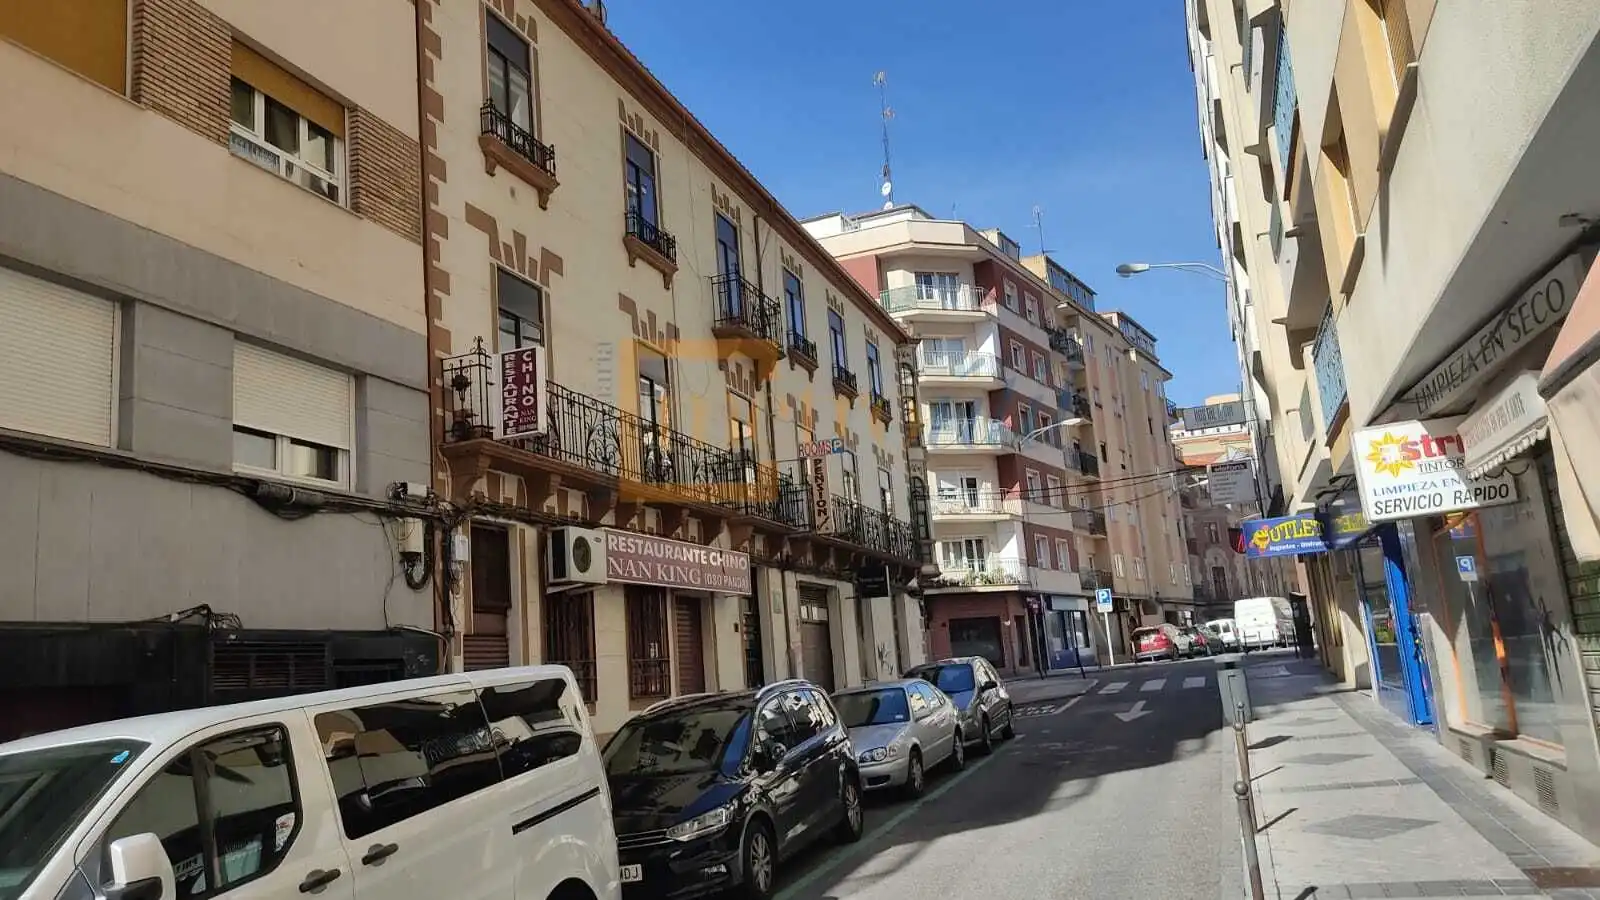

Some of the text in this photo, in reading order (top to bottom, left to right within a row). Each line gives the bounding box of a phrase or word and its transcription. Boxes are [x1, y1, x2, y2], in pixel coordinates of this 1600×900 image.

[1415, 279, 1565, 415] LIMPIEZA EN SECO
[503, 353, 519, 435] RESTAURANTE
[522, 350, 535, 406] CHINO
[800, 440, 832, 457] ROOMS
[814, 458, 828, 517] PENSION
[1373, 480, 1439, 497] LIMPIEZA
[1442, 478, 1461, 489] EN
[1374, 483, 1510, 516] SERVICIO RAPIDO
[607, 556, 652, 580] NAN
[657, 563, 701, 585] KING
[608, 534, 748, 571] RESTAURANTE CHINO
